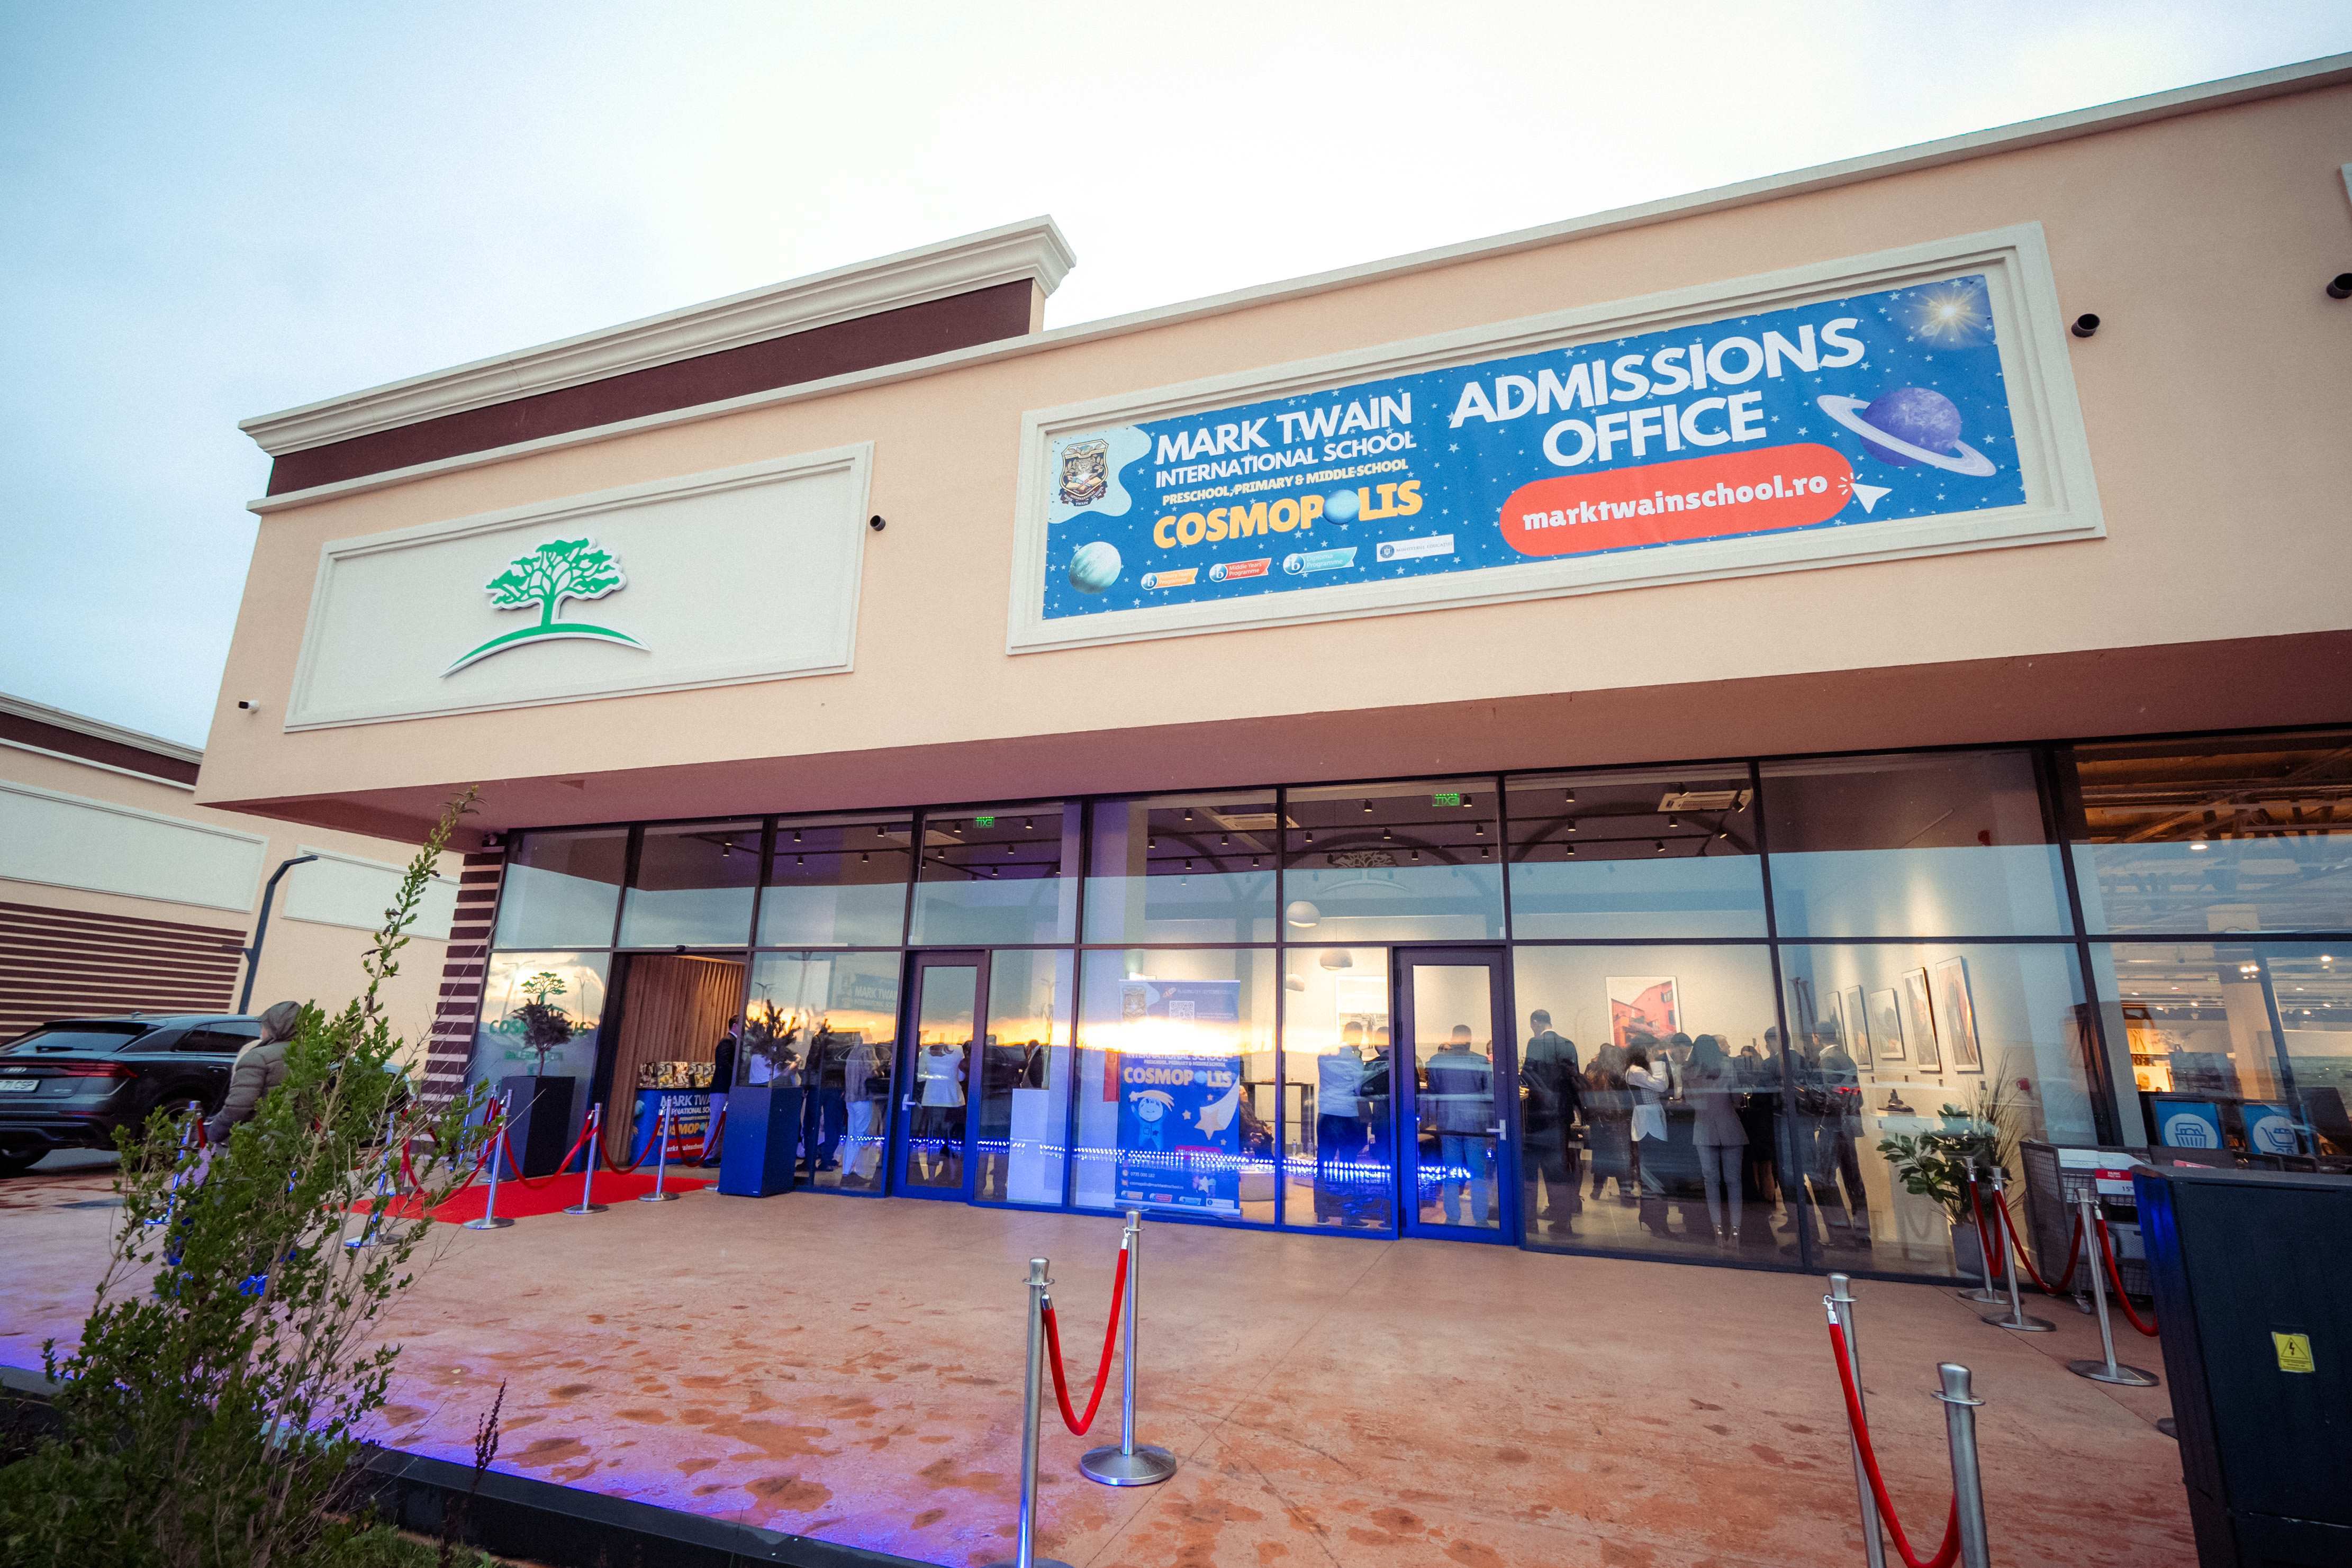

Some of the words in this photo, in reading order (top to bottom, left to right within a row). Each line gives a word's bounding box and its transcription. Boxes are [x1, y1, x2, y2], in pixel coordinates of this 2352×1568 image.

[1449, 318, 1865, 429] ADMISSIONS
[1156, 417, 1270, 465] MARK
[1276, 392, 1413, 445] TWAIN
[1542, 390, 1767, 467] OFFICE
[1156, 447, 1318, 488] INTERNATIONAL
[1323, 431, 1417, 461] SCHOOL
[1234, 476, 1294, 495] PRIMARY
[1295, 474, 1304, 485] &
[1306, 467, 1355, 484] MIDDLE
[1356, 459, 1408, 476] SCHOOL
[1523, 475, 1828, 531] marktwainschool.ro
[1229, 568, 1260, 577] Programme
[1307, 559, 1343, 568] Programme
[878, 988, 898, 1000] TWAI
